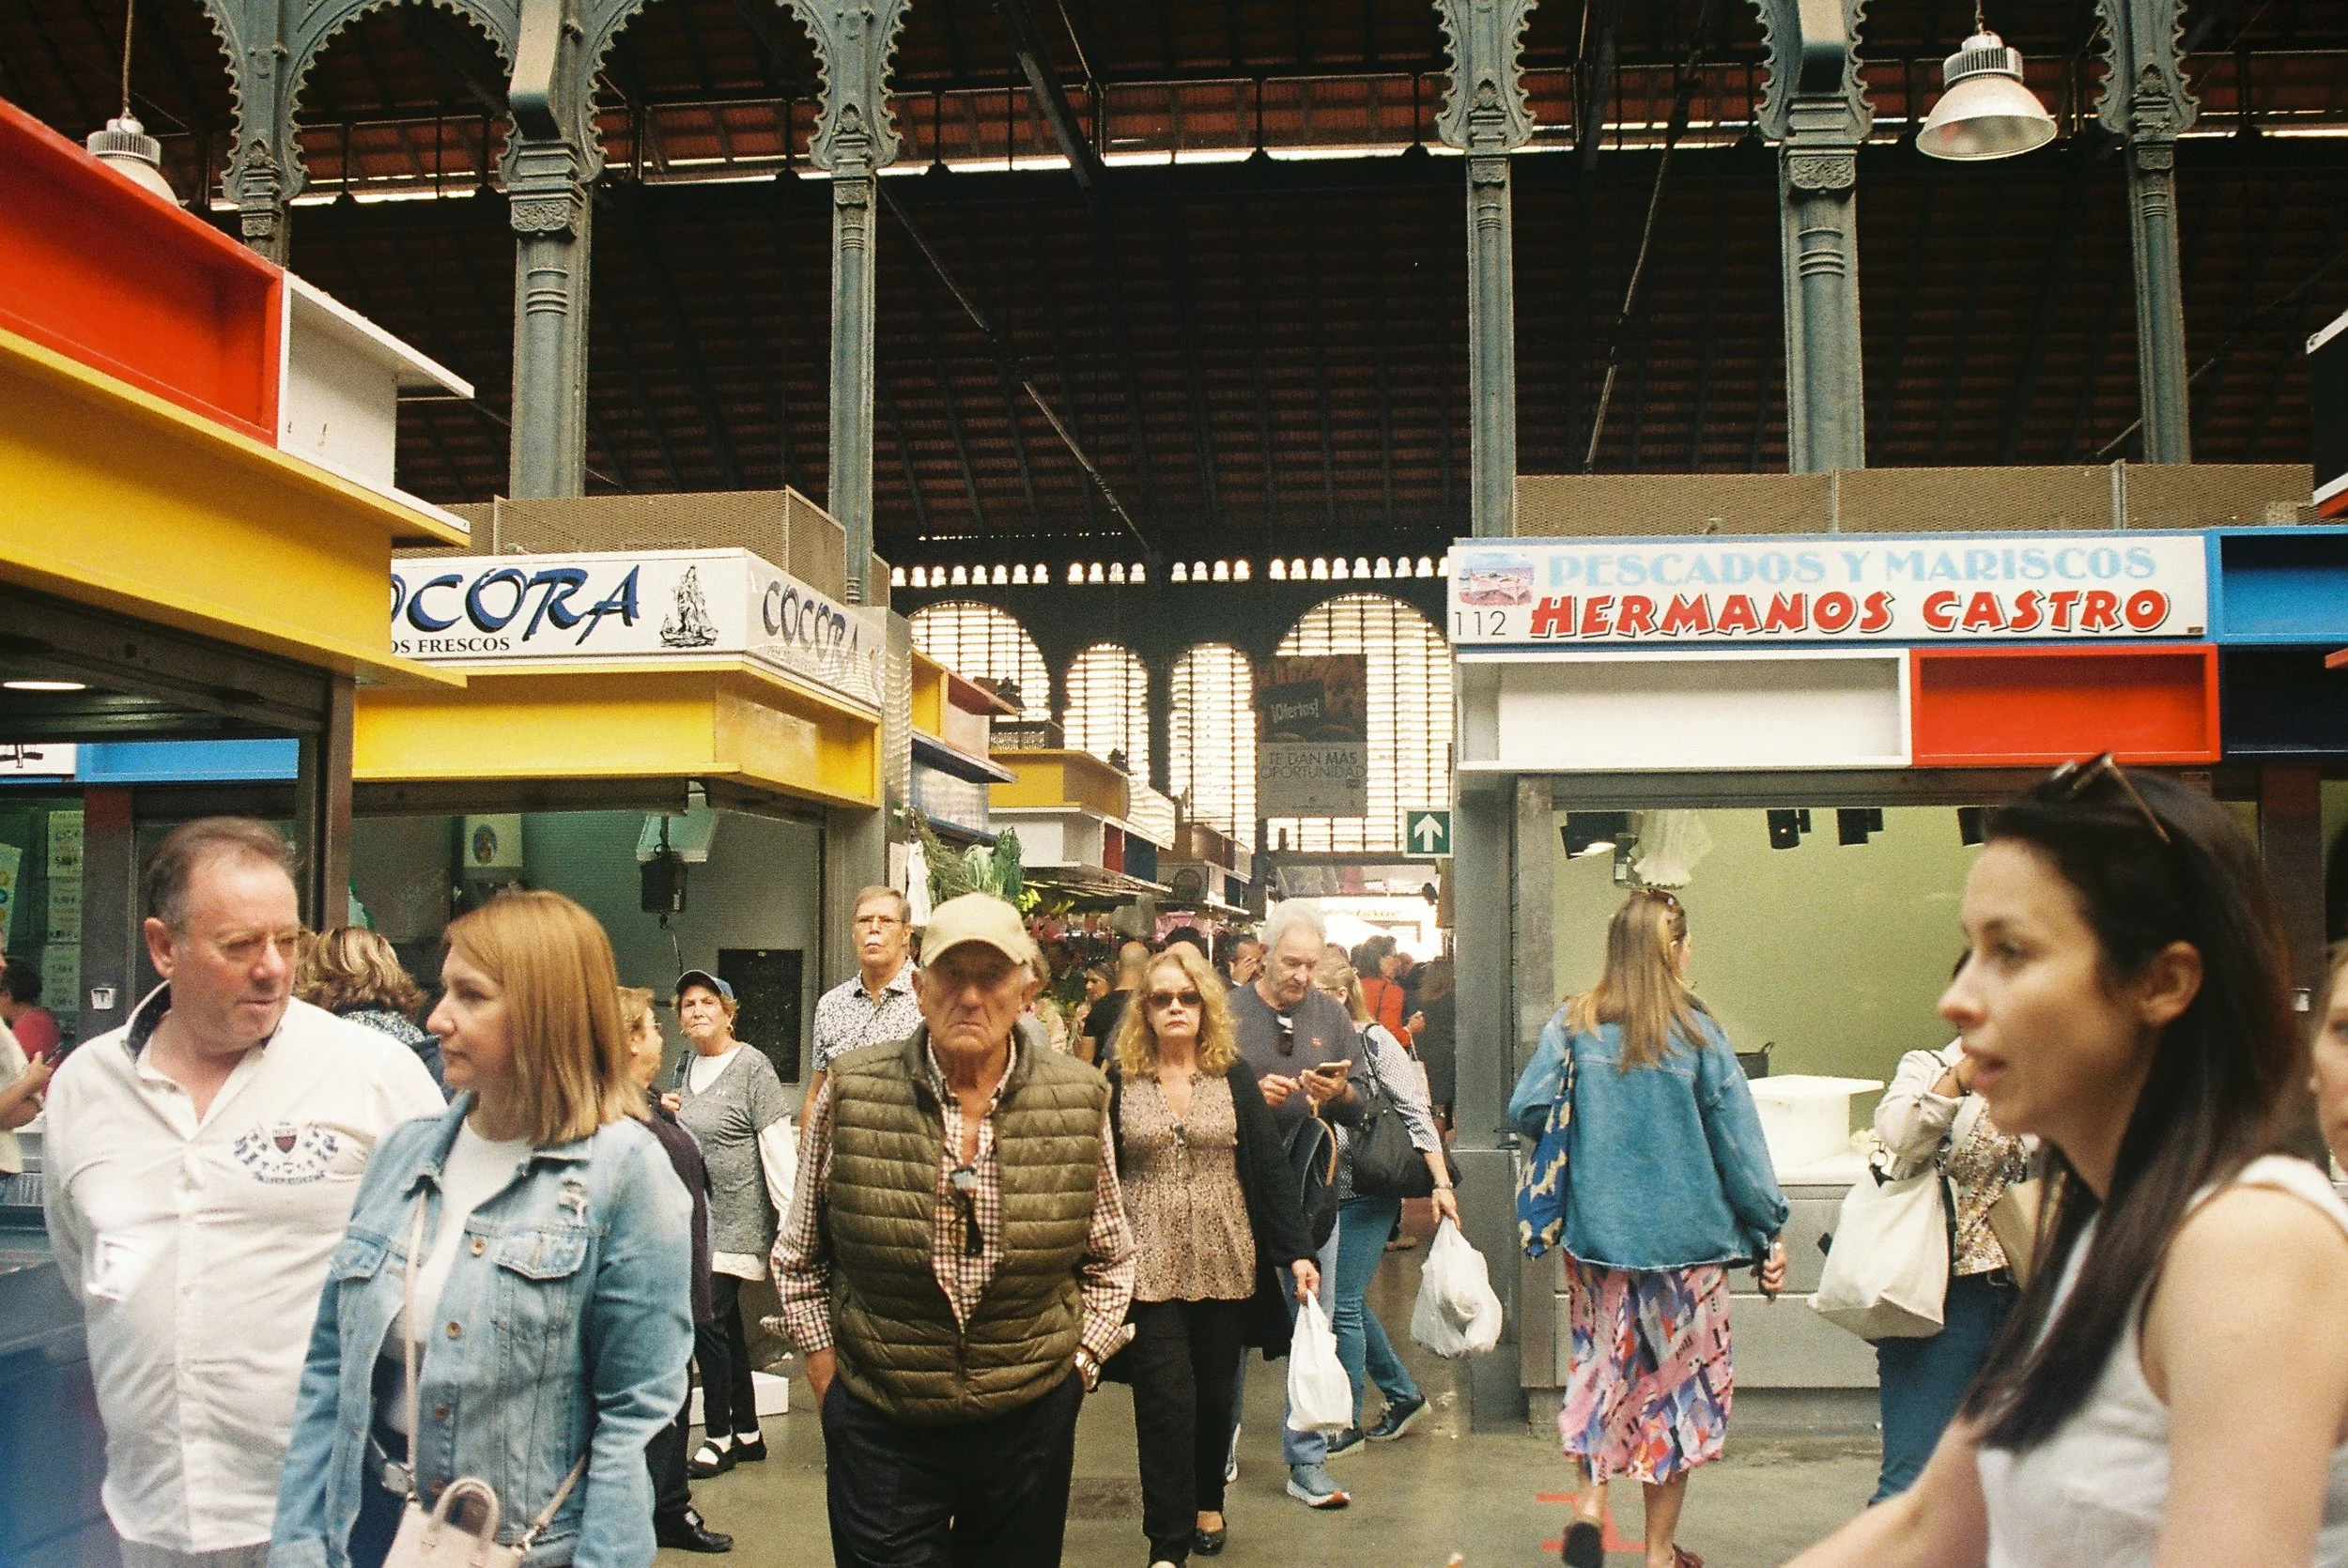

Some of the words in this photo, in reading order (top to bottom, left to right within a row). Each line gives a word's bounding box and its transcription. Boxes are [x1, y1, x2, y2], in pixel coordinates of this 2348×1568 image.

[1549, 551, 1826, 587] PESCADOS
[1840, 551, 1870, 583] Y
[1885, 547, 2156, 581] MARISCOS
[392, 564, 640, 646] CORA
[1529, 590, 1894, 638] HERMANOS
[1922, 590, 2170, 633] CASTRO
[763, 580, 858, 674] COCORA
[1455, 610, 1506, 637] 112
[418, 638, 511, 653] FRESCOS
[1260, 766, 1367, 778] OPORTUNIDAD
[1268, 752, 1283, 765] TE
[1288, 752, 1321, 765] DAN
